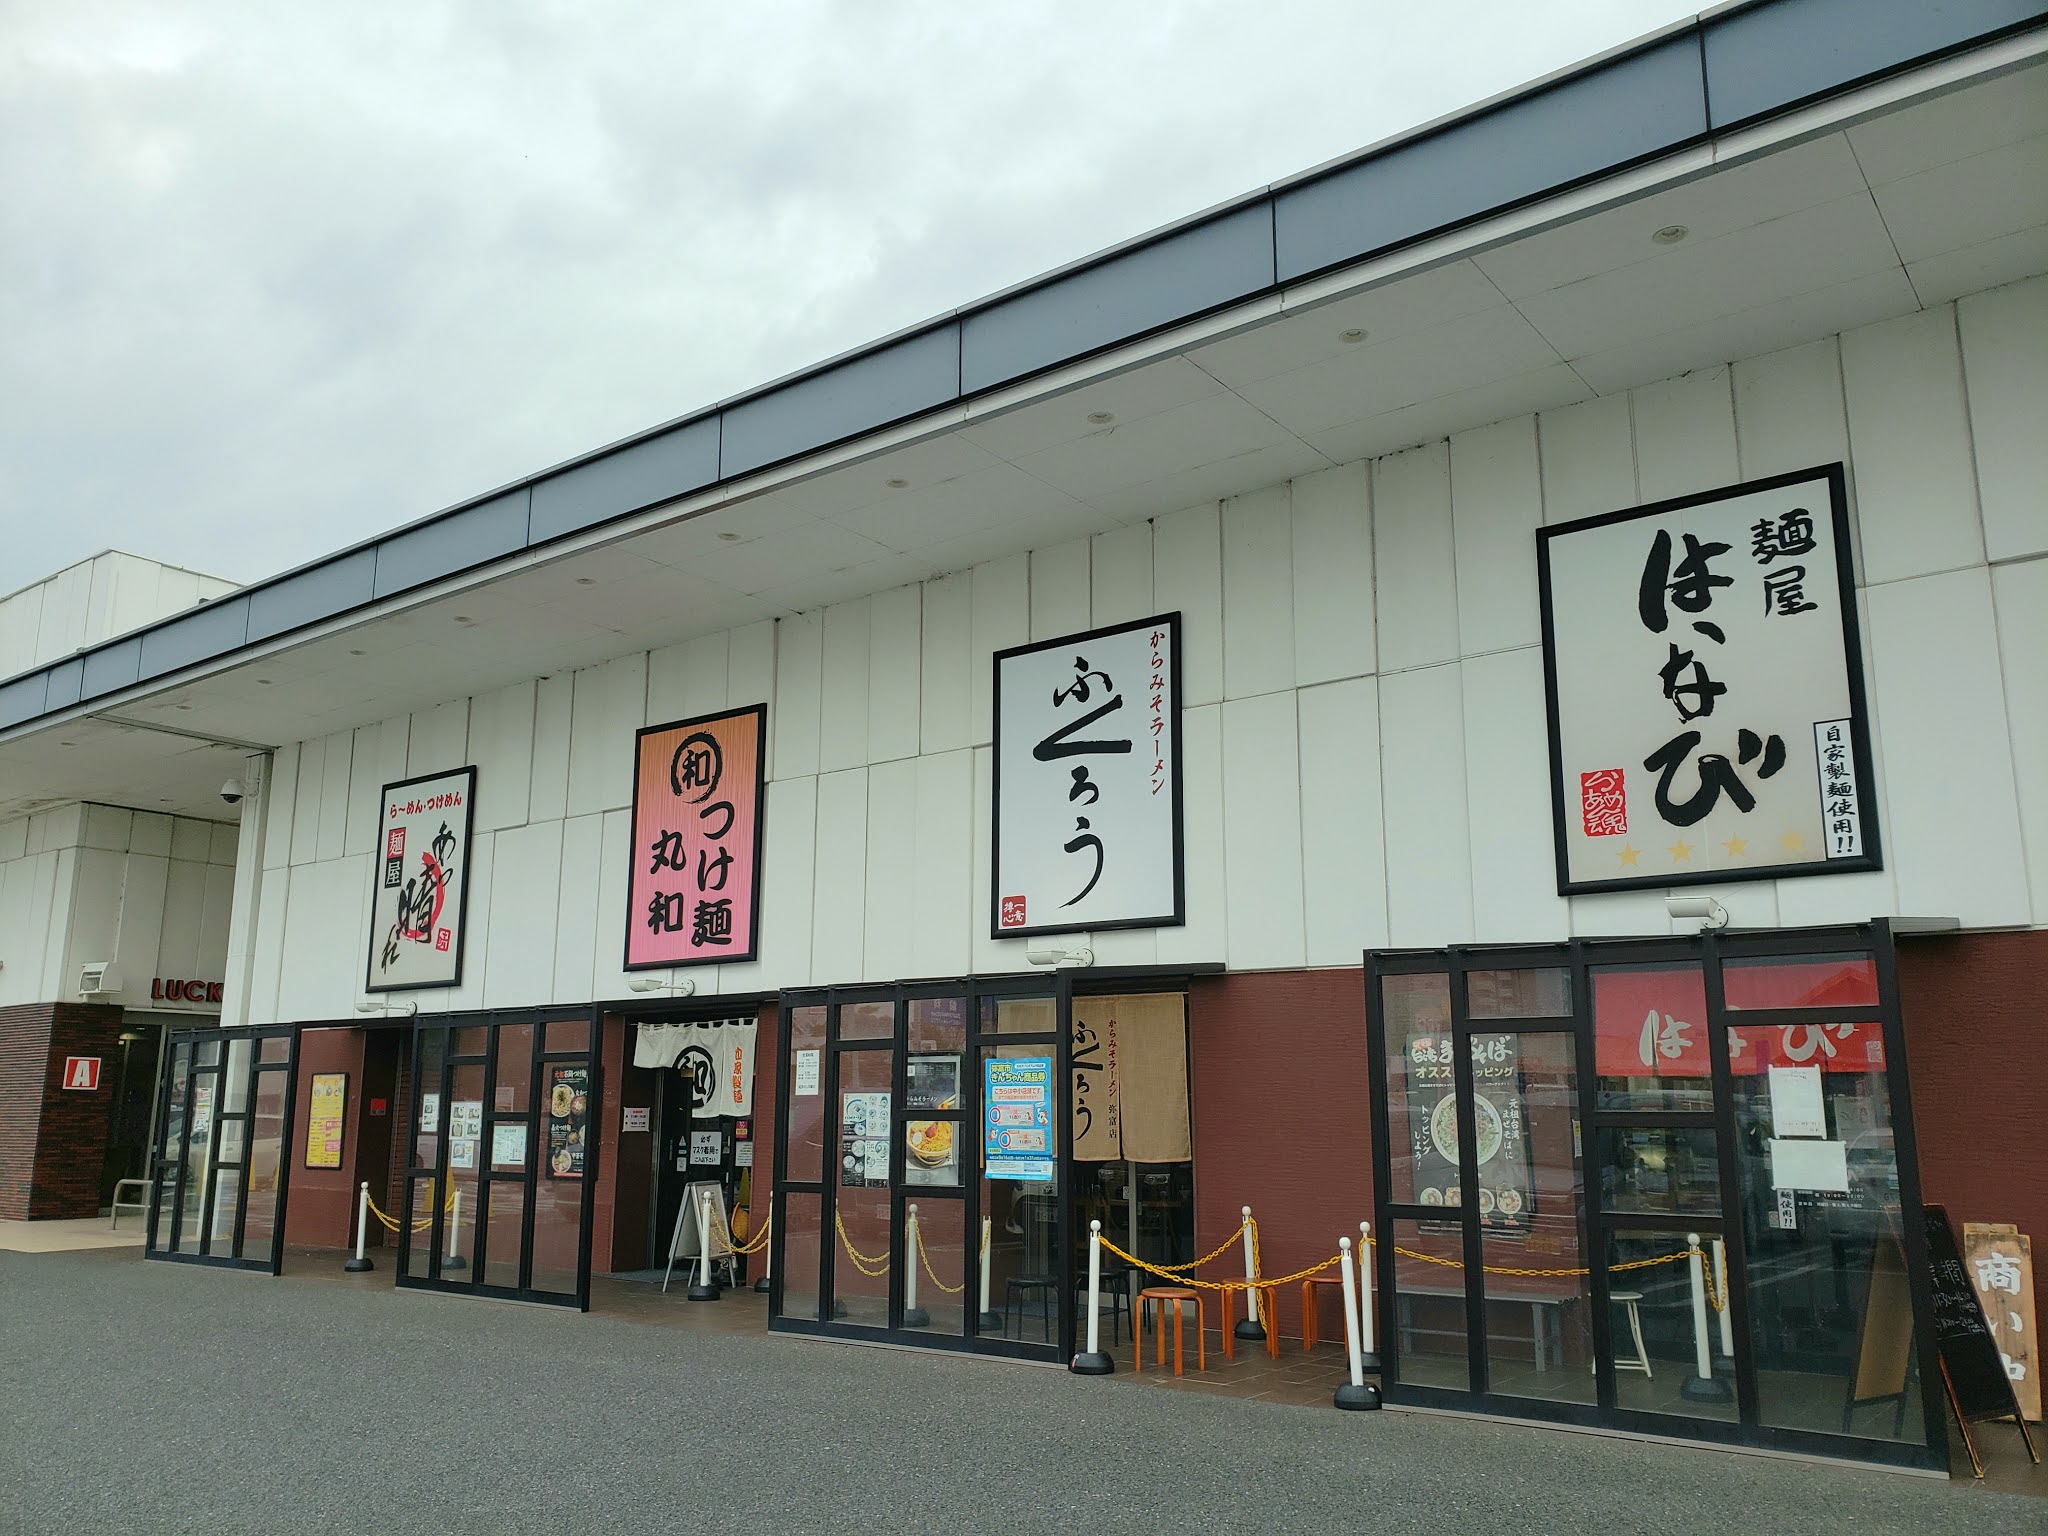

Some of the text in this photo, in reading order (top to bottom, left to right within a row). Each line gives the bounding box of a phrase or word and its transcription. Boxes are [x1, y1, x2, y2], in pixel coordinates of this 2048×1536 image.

[1750, 508, 1819, 618] 麺屋
[1149, 631, 1165, 796] からみそラーメン
[1639, 529, 1787, 827] はなび
[1032, 656, 1132, 909] ふくろう
[386, 831, 405, 886] 麺屋
[647, 829, 686, 935] 丸和
[691, 800, 735, 947] つけ麺
[72, 1061, 90, 1087] A
[1108, 1019, 1117, 1097] からみそラーメン
[1421, 1104, 1432, 1156] トッピング
[1502, 1111, 1513, 1160] まぜそばに
